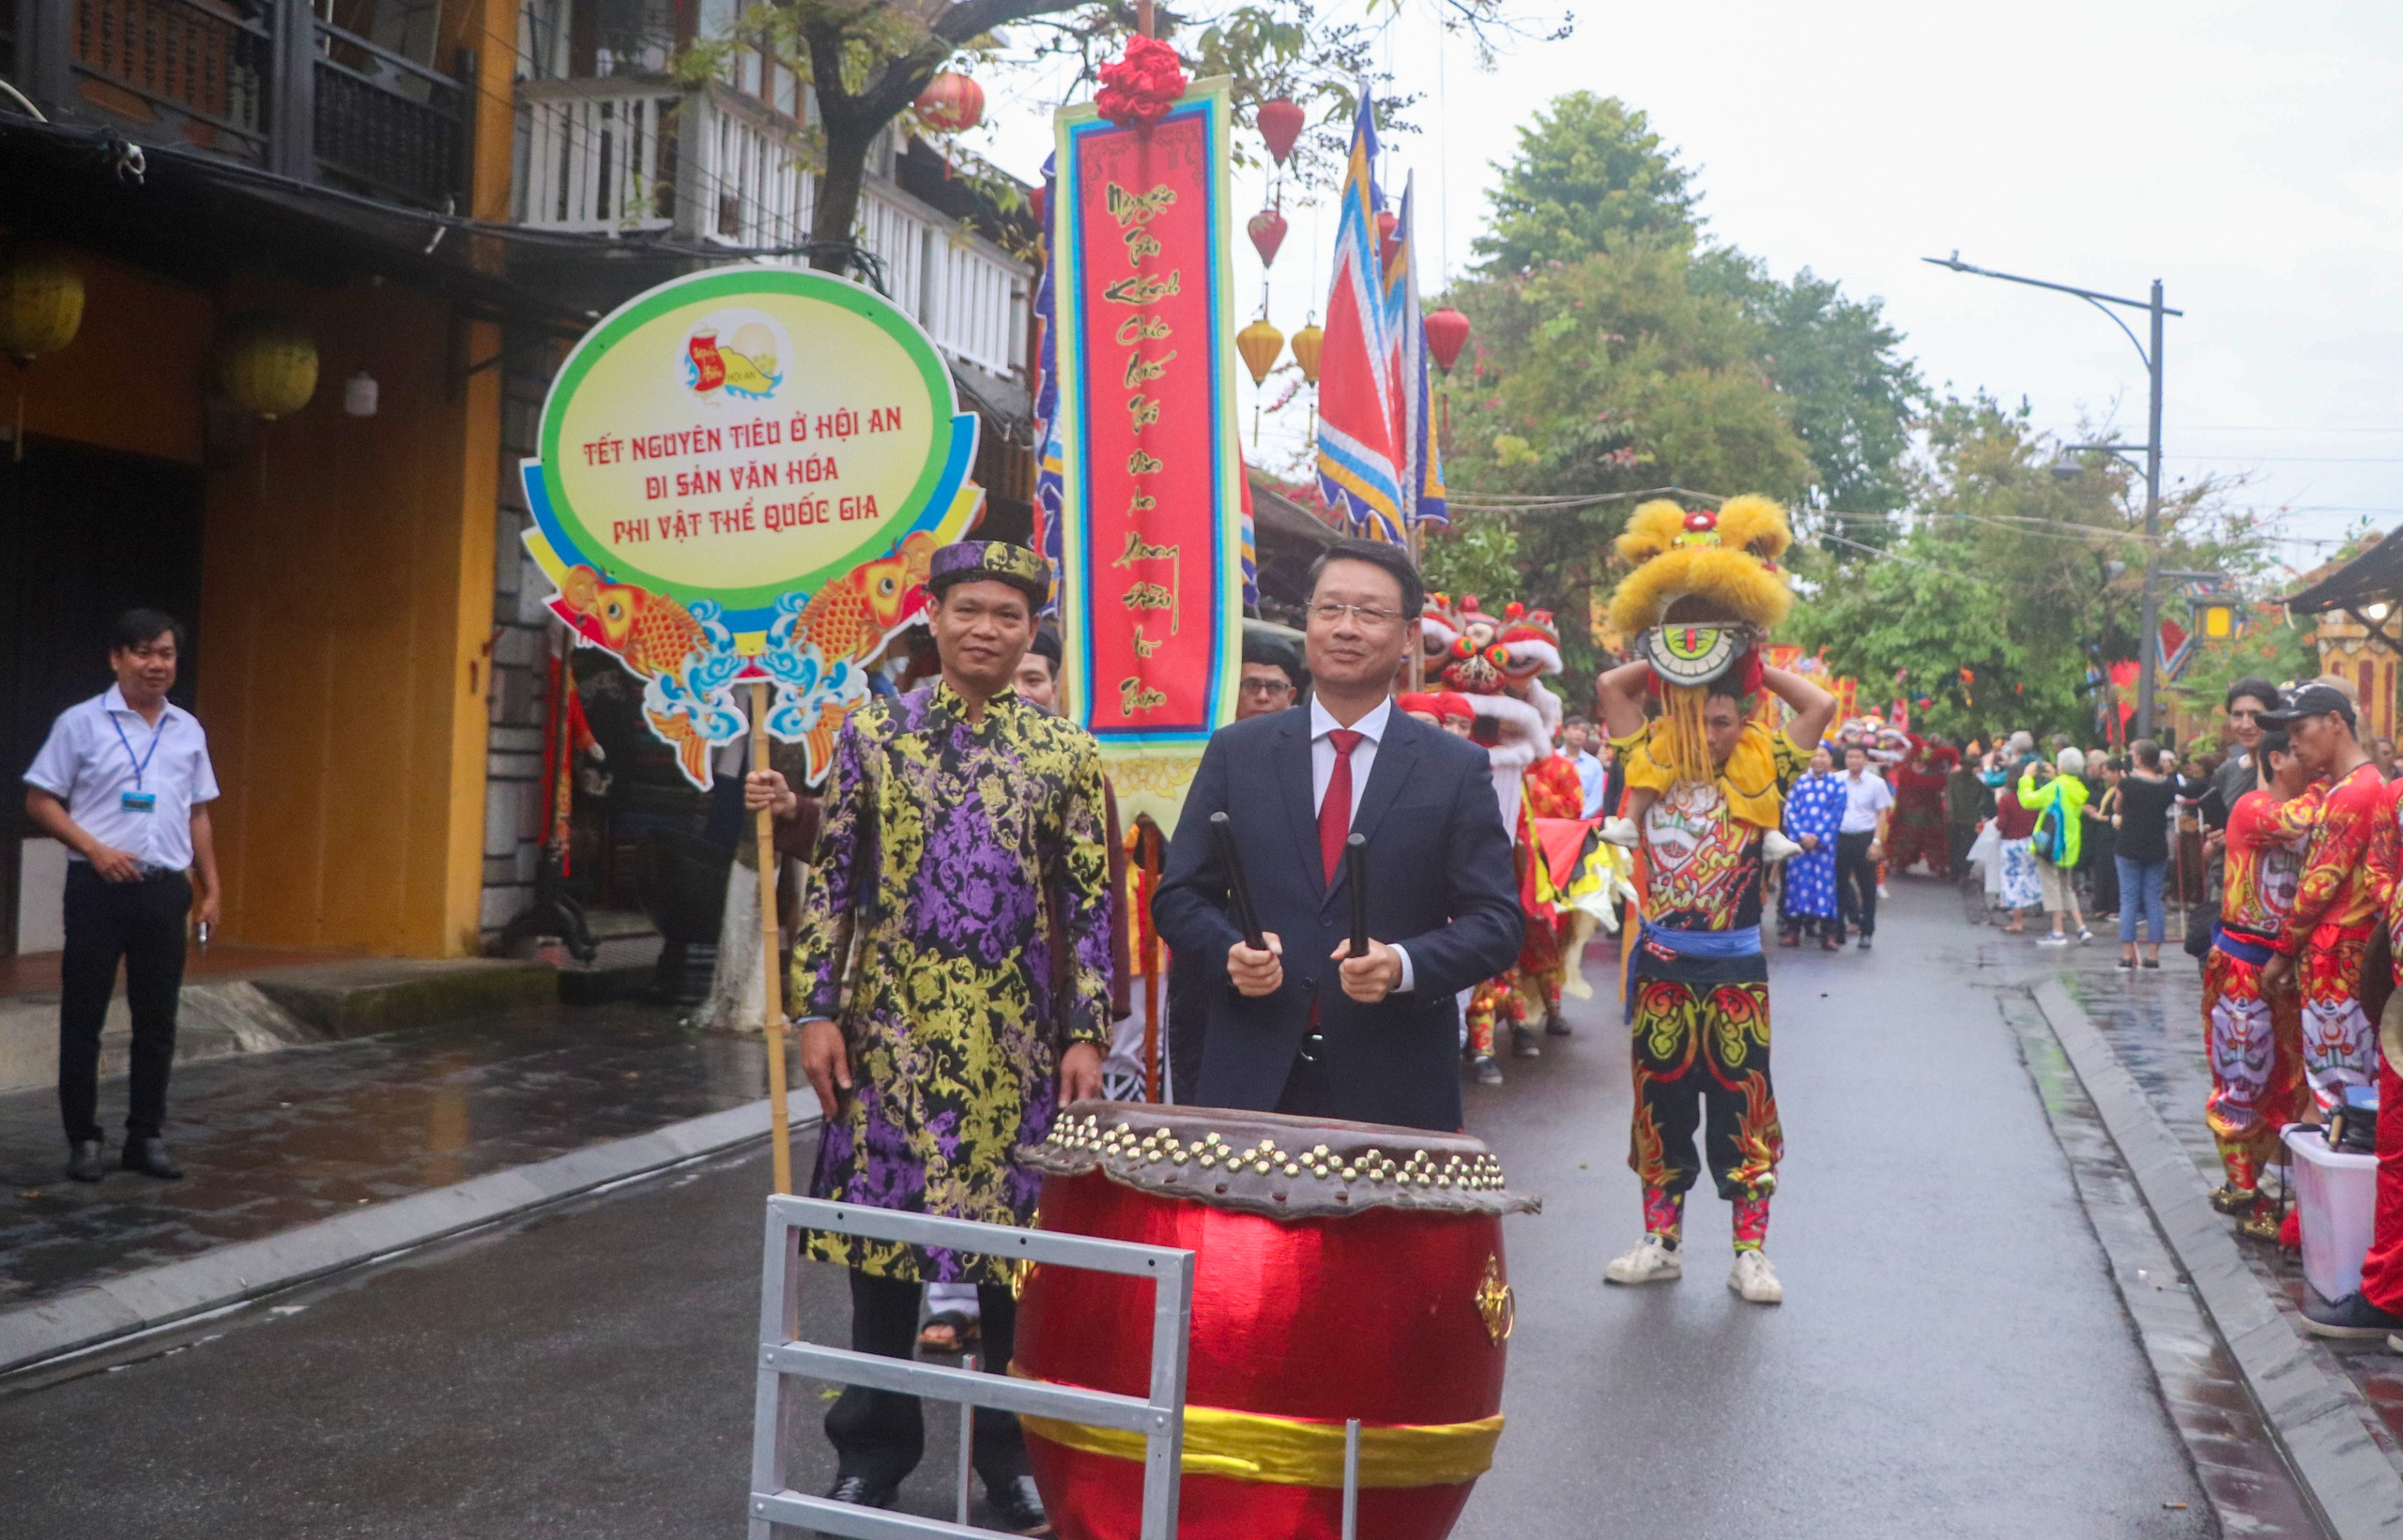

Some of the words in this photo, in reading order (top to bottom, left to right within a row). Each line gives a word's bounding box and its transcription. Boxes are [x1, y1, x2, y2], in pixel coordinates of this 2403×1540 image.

[1106, 182, 1177, 227] Nguyên
[1125, 226, 1161, 267] Tiêu
[1103, 269, 1181, 306] Khánh
[1115, 314, 1172, 346] Chúc
[1127, 393, 1161, 435] Thái
[583, 432, 624, 466] TẾT
[632, 424, 723, 461] NGUYÊN
[729, 418, 781, 450] TIÊU
[790, 410, 808, 442] Ở
[815, 407, 860, 444] HỘI
[868, 405, 903, 433] AN
[645, 476, 668, 500] DI
[676, 465, 722, 497] SẢN
[729, 460, 778, 492] VĂN
[786, 453, 839, 485] HÓA
[1127, 448, 1163, 477] Dân
[613, 519, 650, 544] PHI
[657, 509, 702, 544] VẬT
[709, 497, 757, 533] THỂ
[764, 492, 831, 533] QUỐC
[839, 494, 880, 522] GIA
[1122, 581, 1172, 611] Điều
[1119, 676, 1167, 717] Thuận
